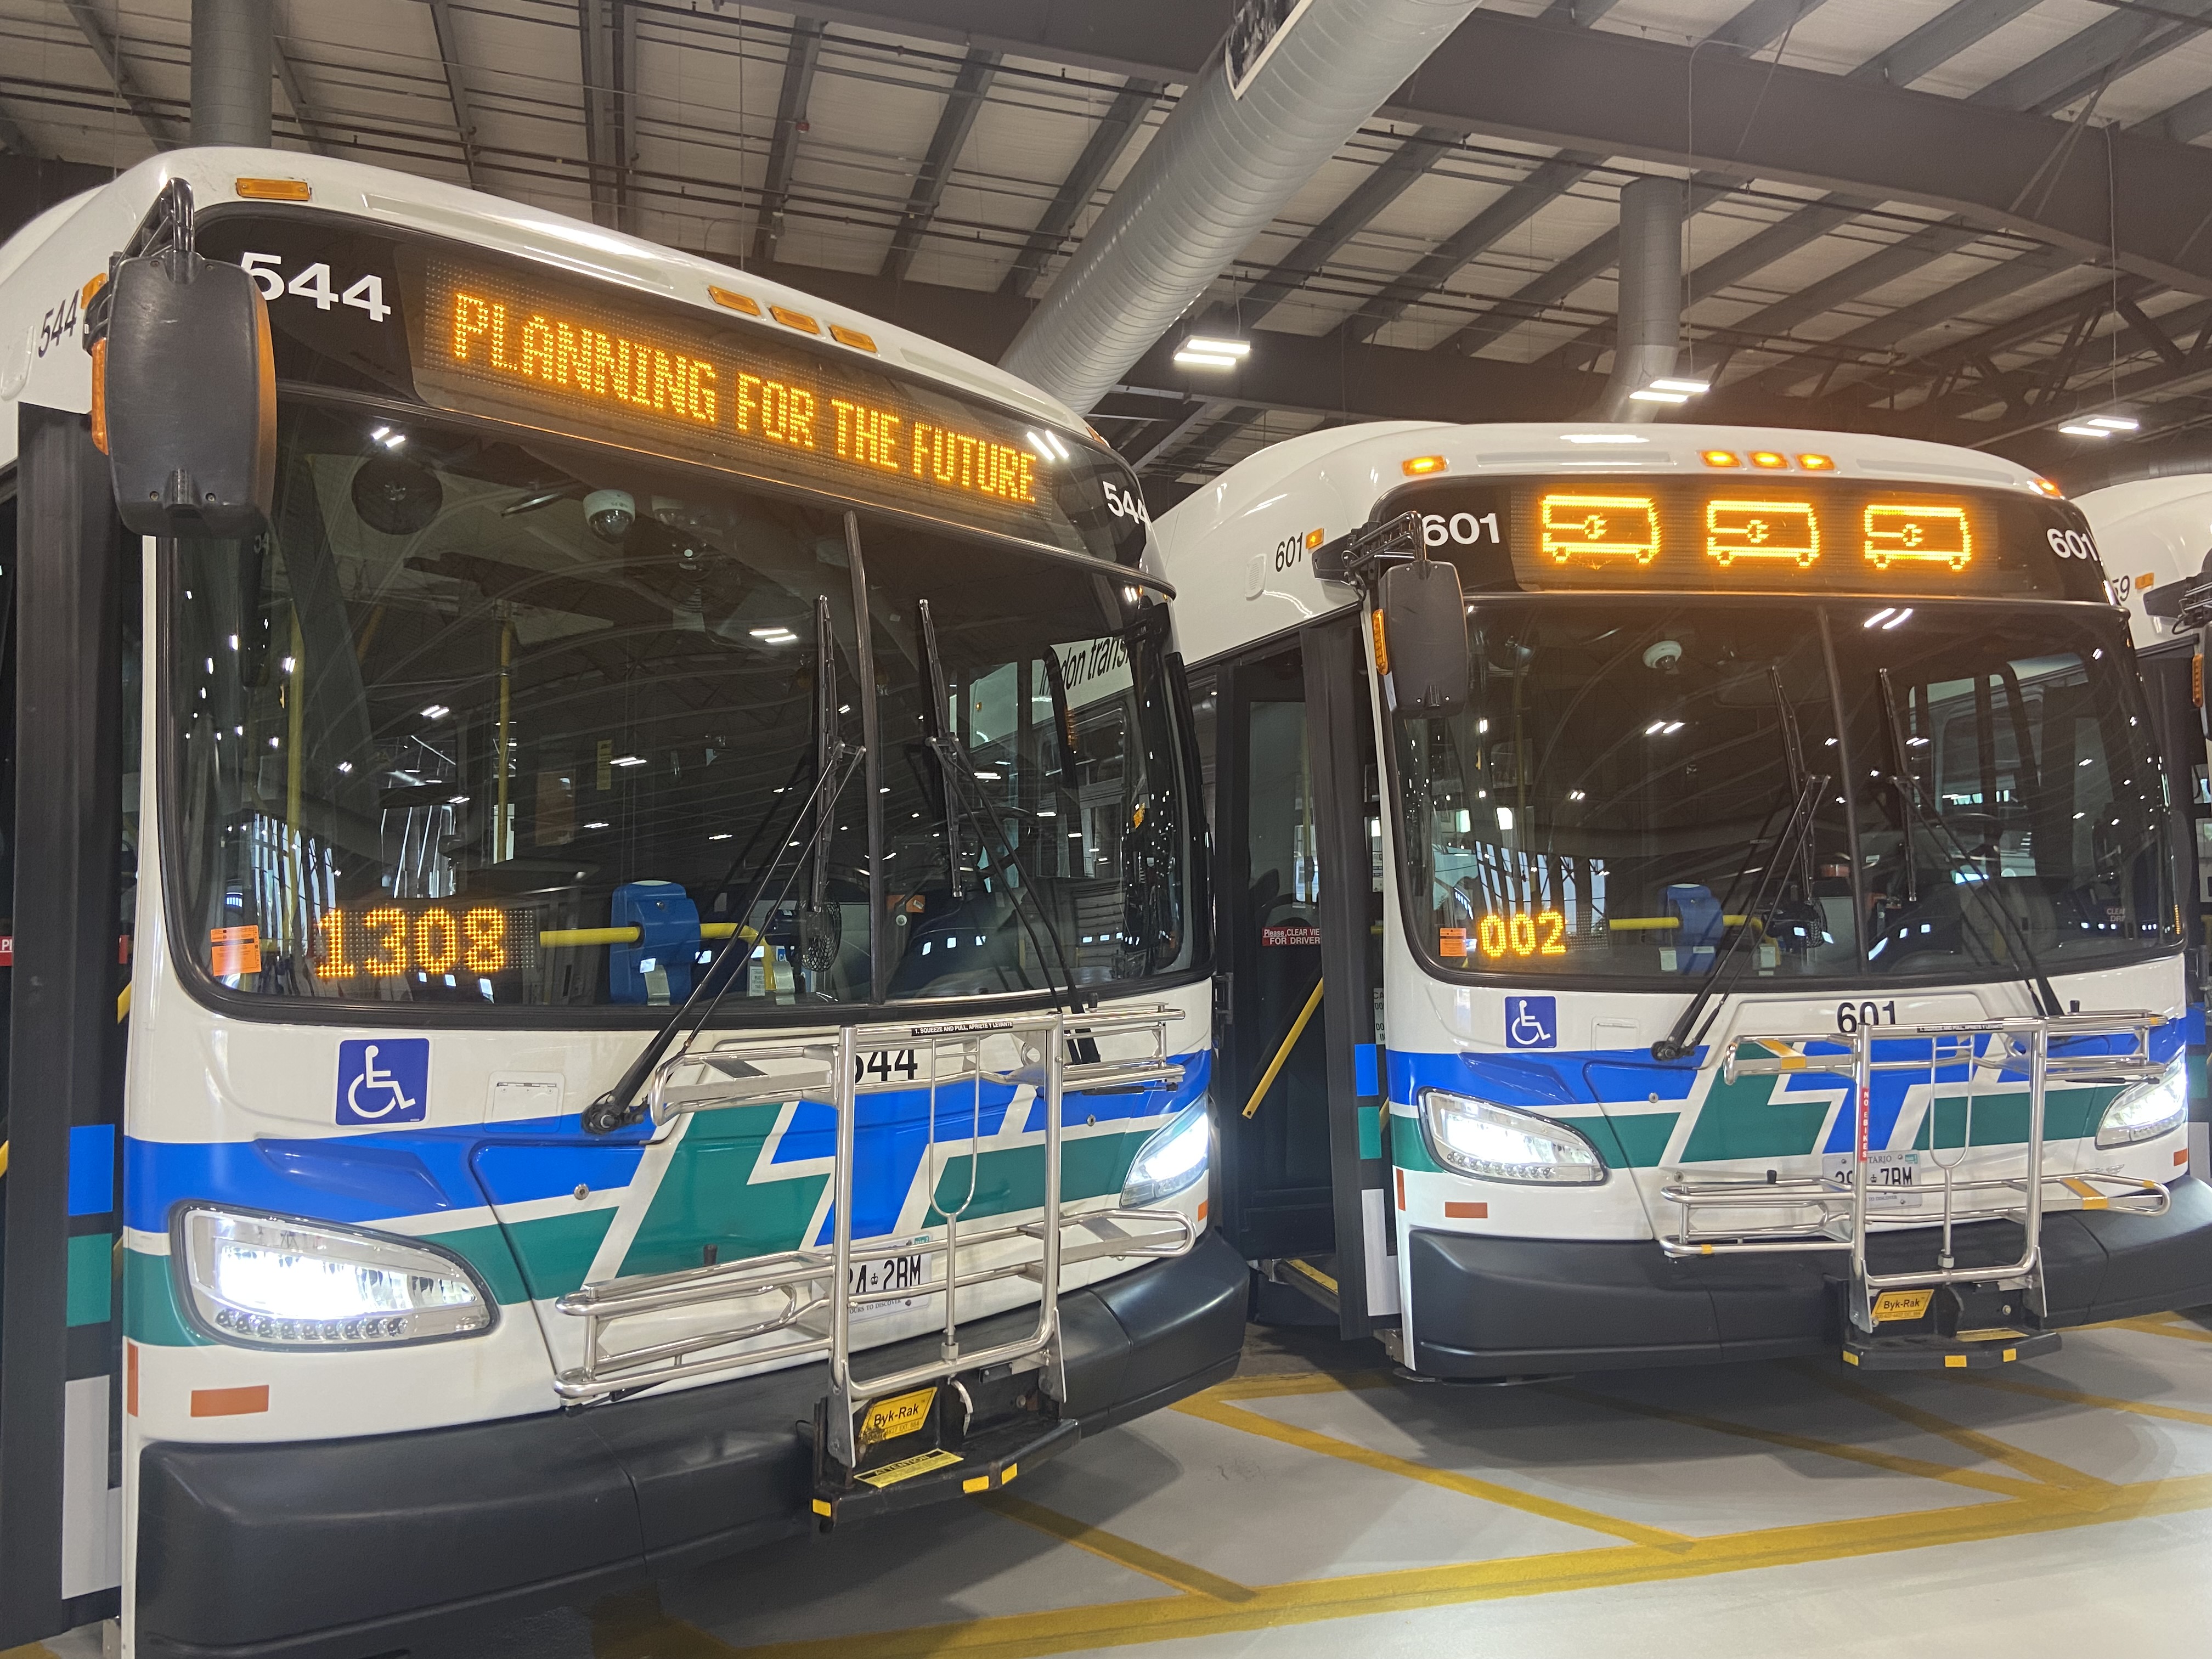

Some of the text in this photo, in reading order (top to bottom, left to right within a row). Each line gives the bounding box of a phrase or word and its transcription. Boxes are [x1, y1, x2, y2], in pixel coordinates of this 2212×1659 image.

[241, 252, 391, 323] 544
[38, 288, 81, 358] 544
[454, 292, 1037, 503] PLANNING FOR THE FUTURE
[1102, 481, 1151, 532] 544
[1424, 512, 1500, 546] 601
[2046, 528, 2098, 560] 601
[1275, 532, 1304, 573] 601
[317, 907, 504, 978] 1308
[1480, 911, 1566, 957] 002
[1837, 1001, 1896, 1034] 601
[1864, 1092, 1869, 1106] NO
[1867, 1155, 1892, 1164] TARIO
[849, 1306, 864, 1314] OURS
[875, 1300, 901, 1310] DISCOVER
[1883, 1298, 1920, 1311] Byk-Rak
[874, 1403, 919, 1427] Byk-Rak
